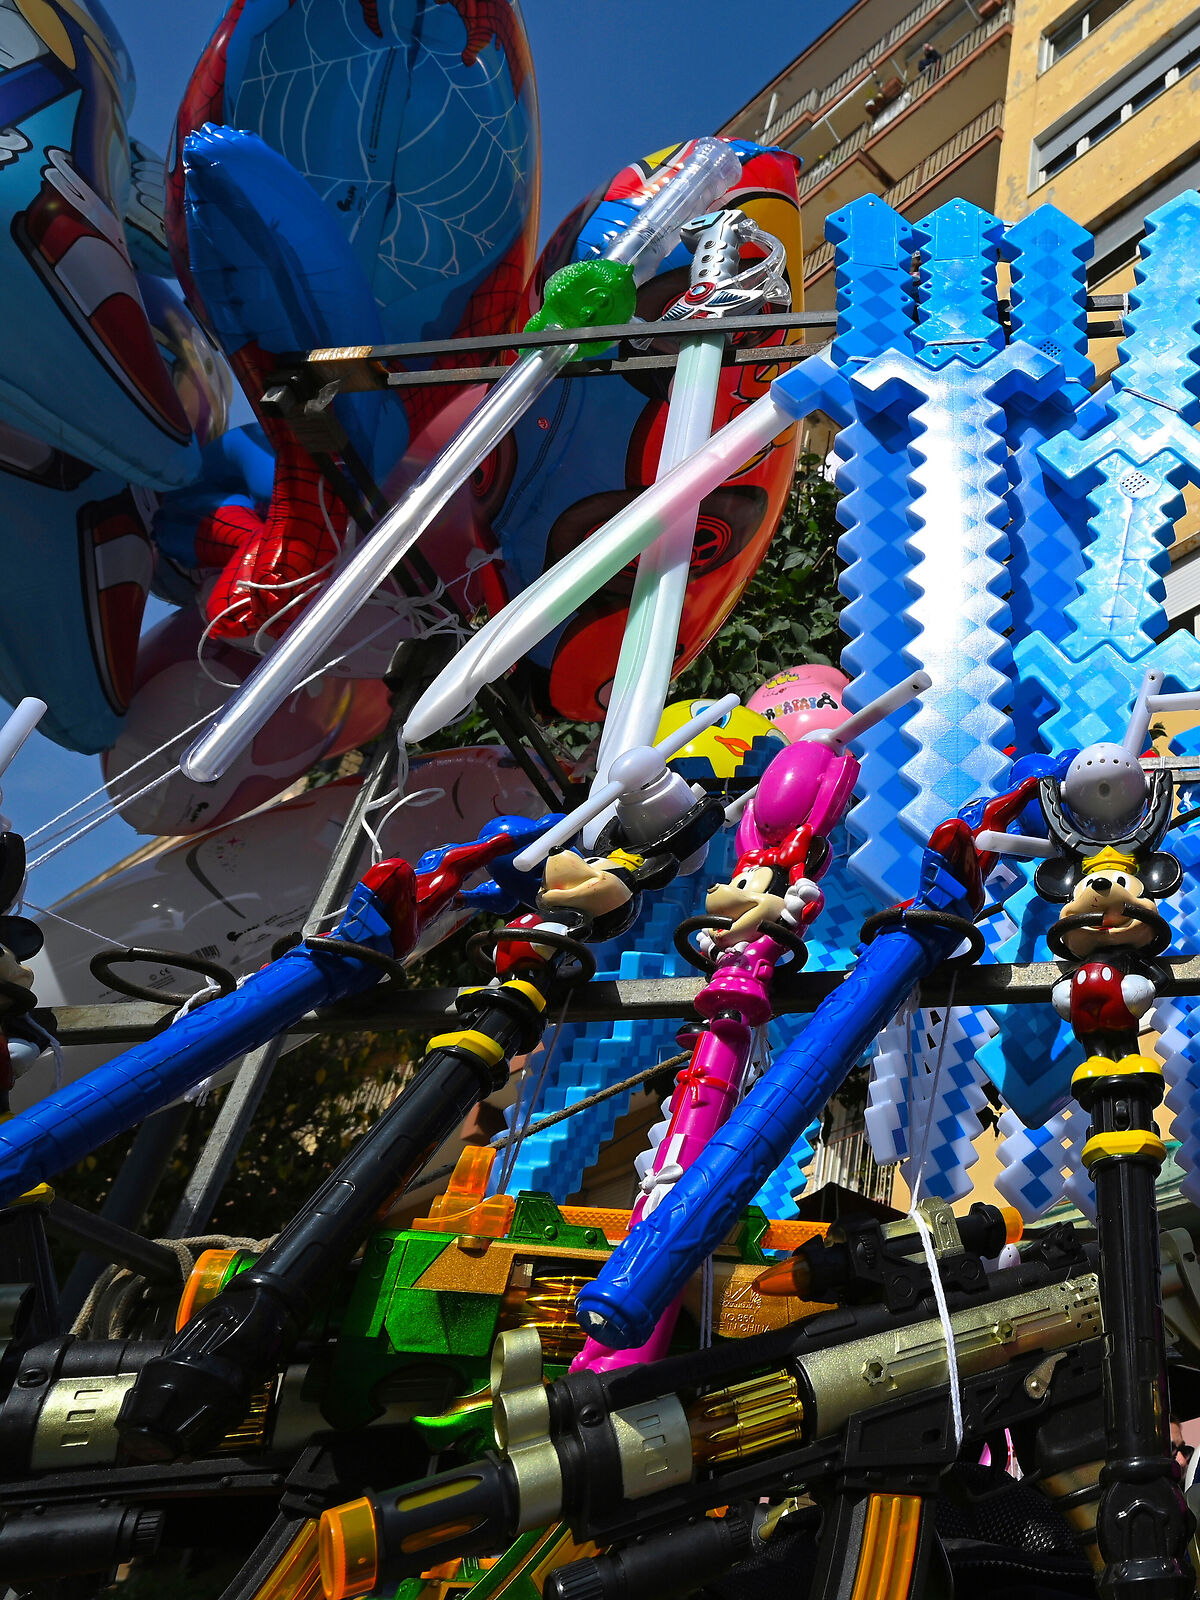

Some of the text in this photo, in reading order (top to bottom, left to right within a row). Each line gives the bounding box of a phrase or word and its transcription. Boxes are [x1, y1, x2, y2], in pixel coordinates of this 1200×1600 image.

[761, 692, 839, 721] RBAPAPA
[726, 1322, 738, 1331] IN
[739, 1323, 770, 1333] CHINA
